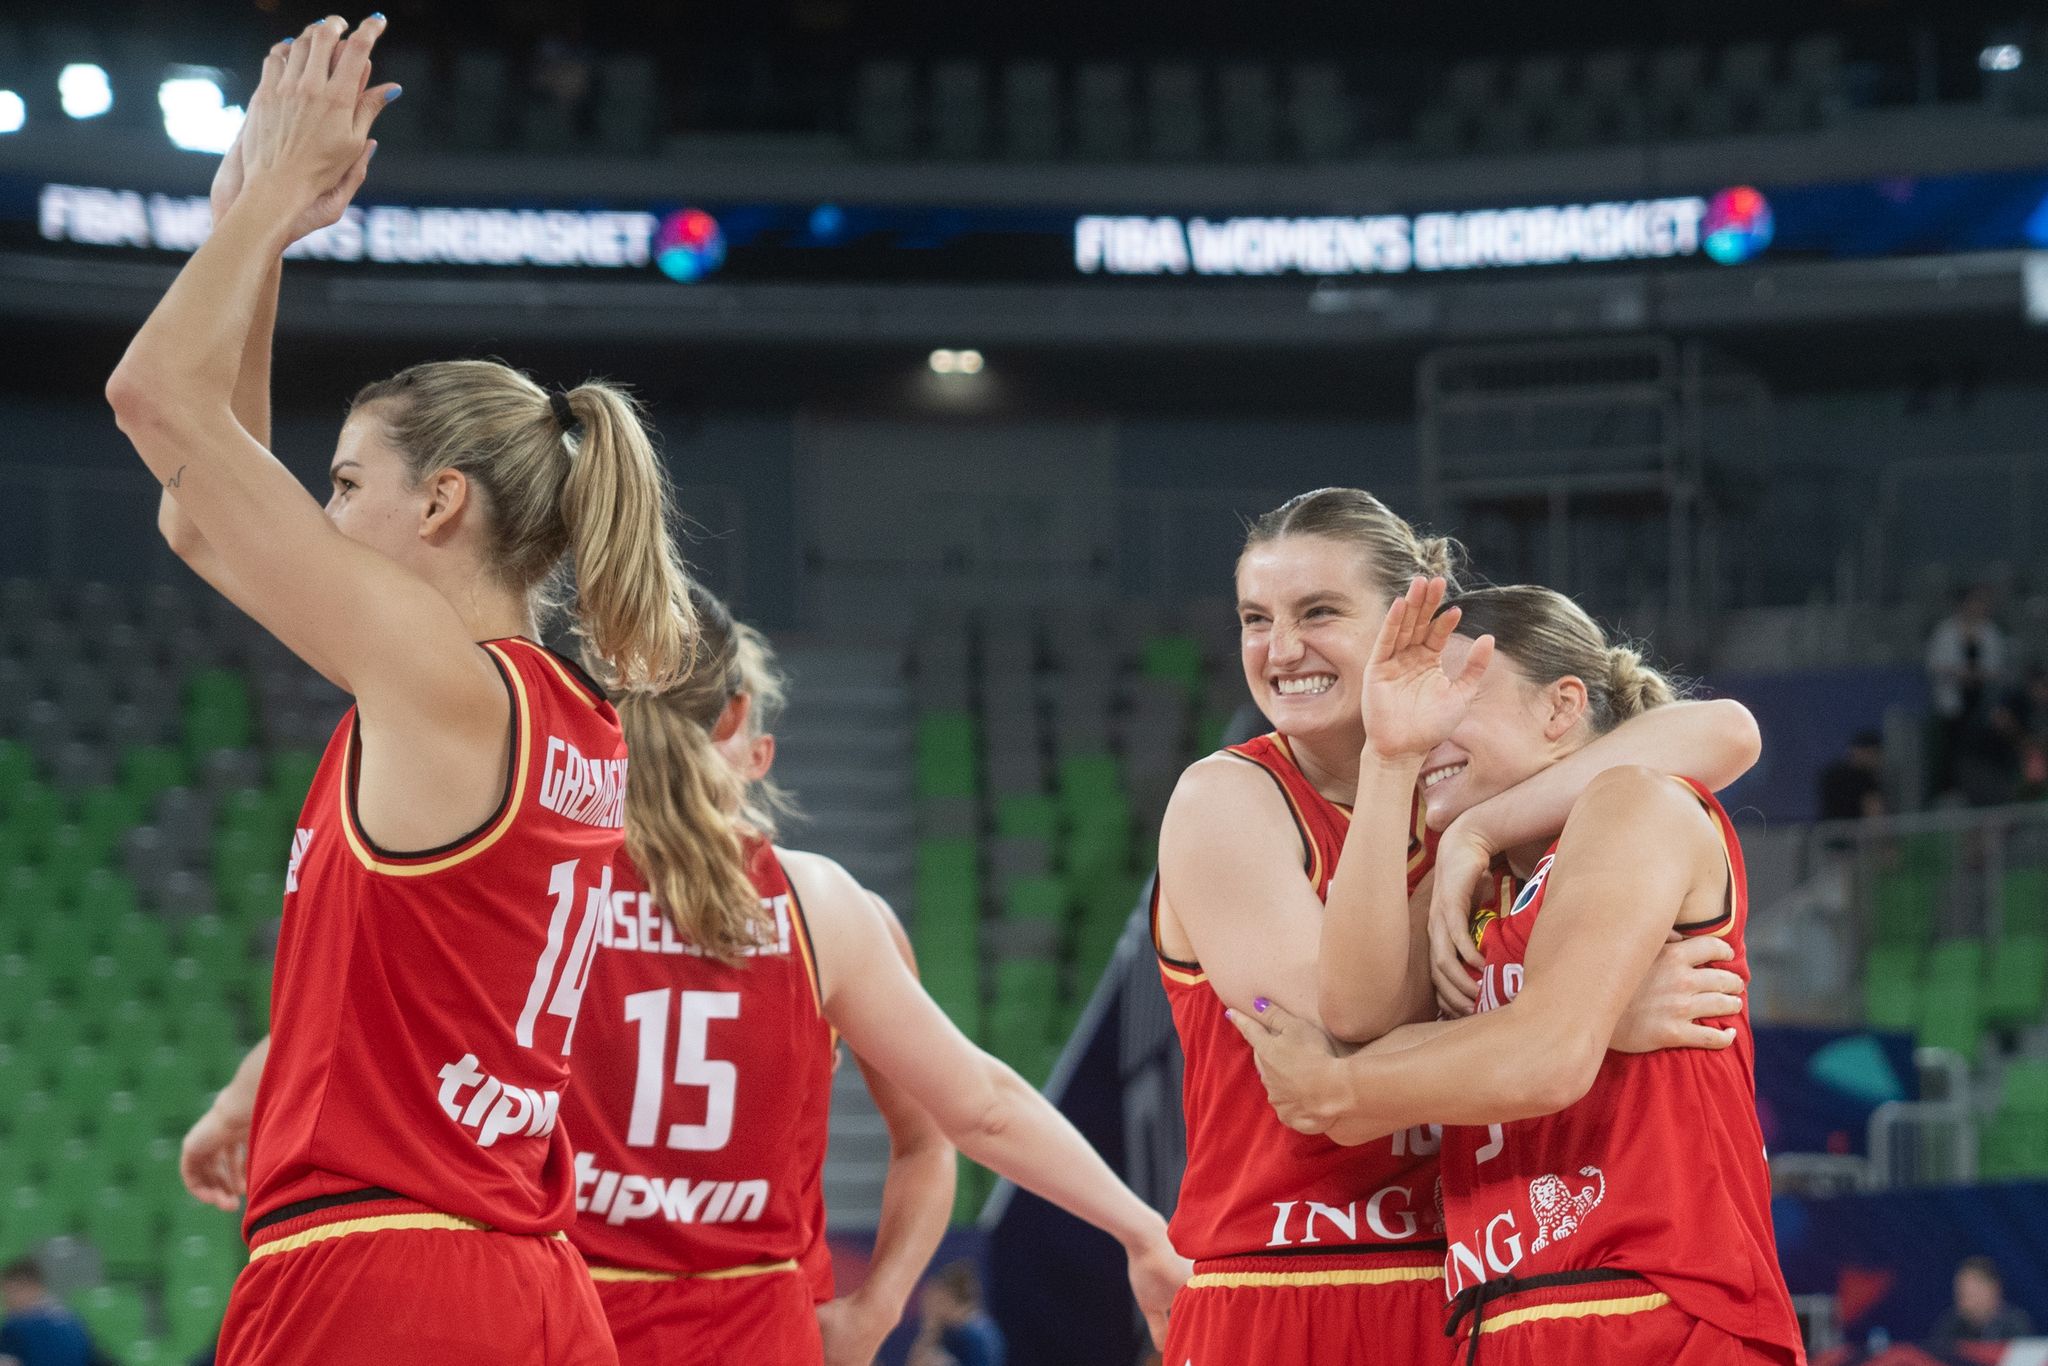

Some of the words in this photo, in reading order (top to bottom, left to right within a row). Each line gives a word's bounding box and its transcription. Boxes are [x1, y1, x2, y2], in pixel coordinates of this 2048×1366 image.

[40, 183, 149, 248] FIBA
[1075, 217, 1188, 273] FIBA
[1413, 196, 1704, 271] EUROBASKET
[515, 858, 613, 1057] 14
[624, 987, 740, 1151] 15
[1266, 1185, 1417, 1246] ING
